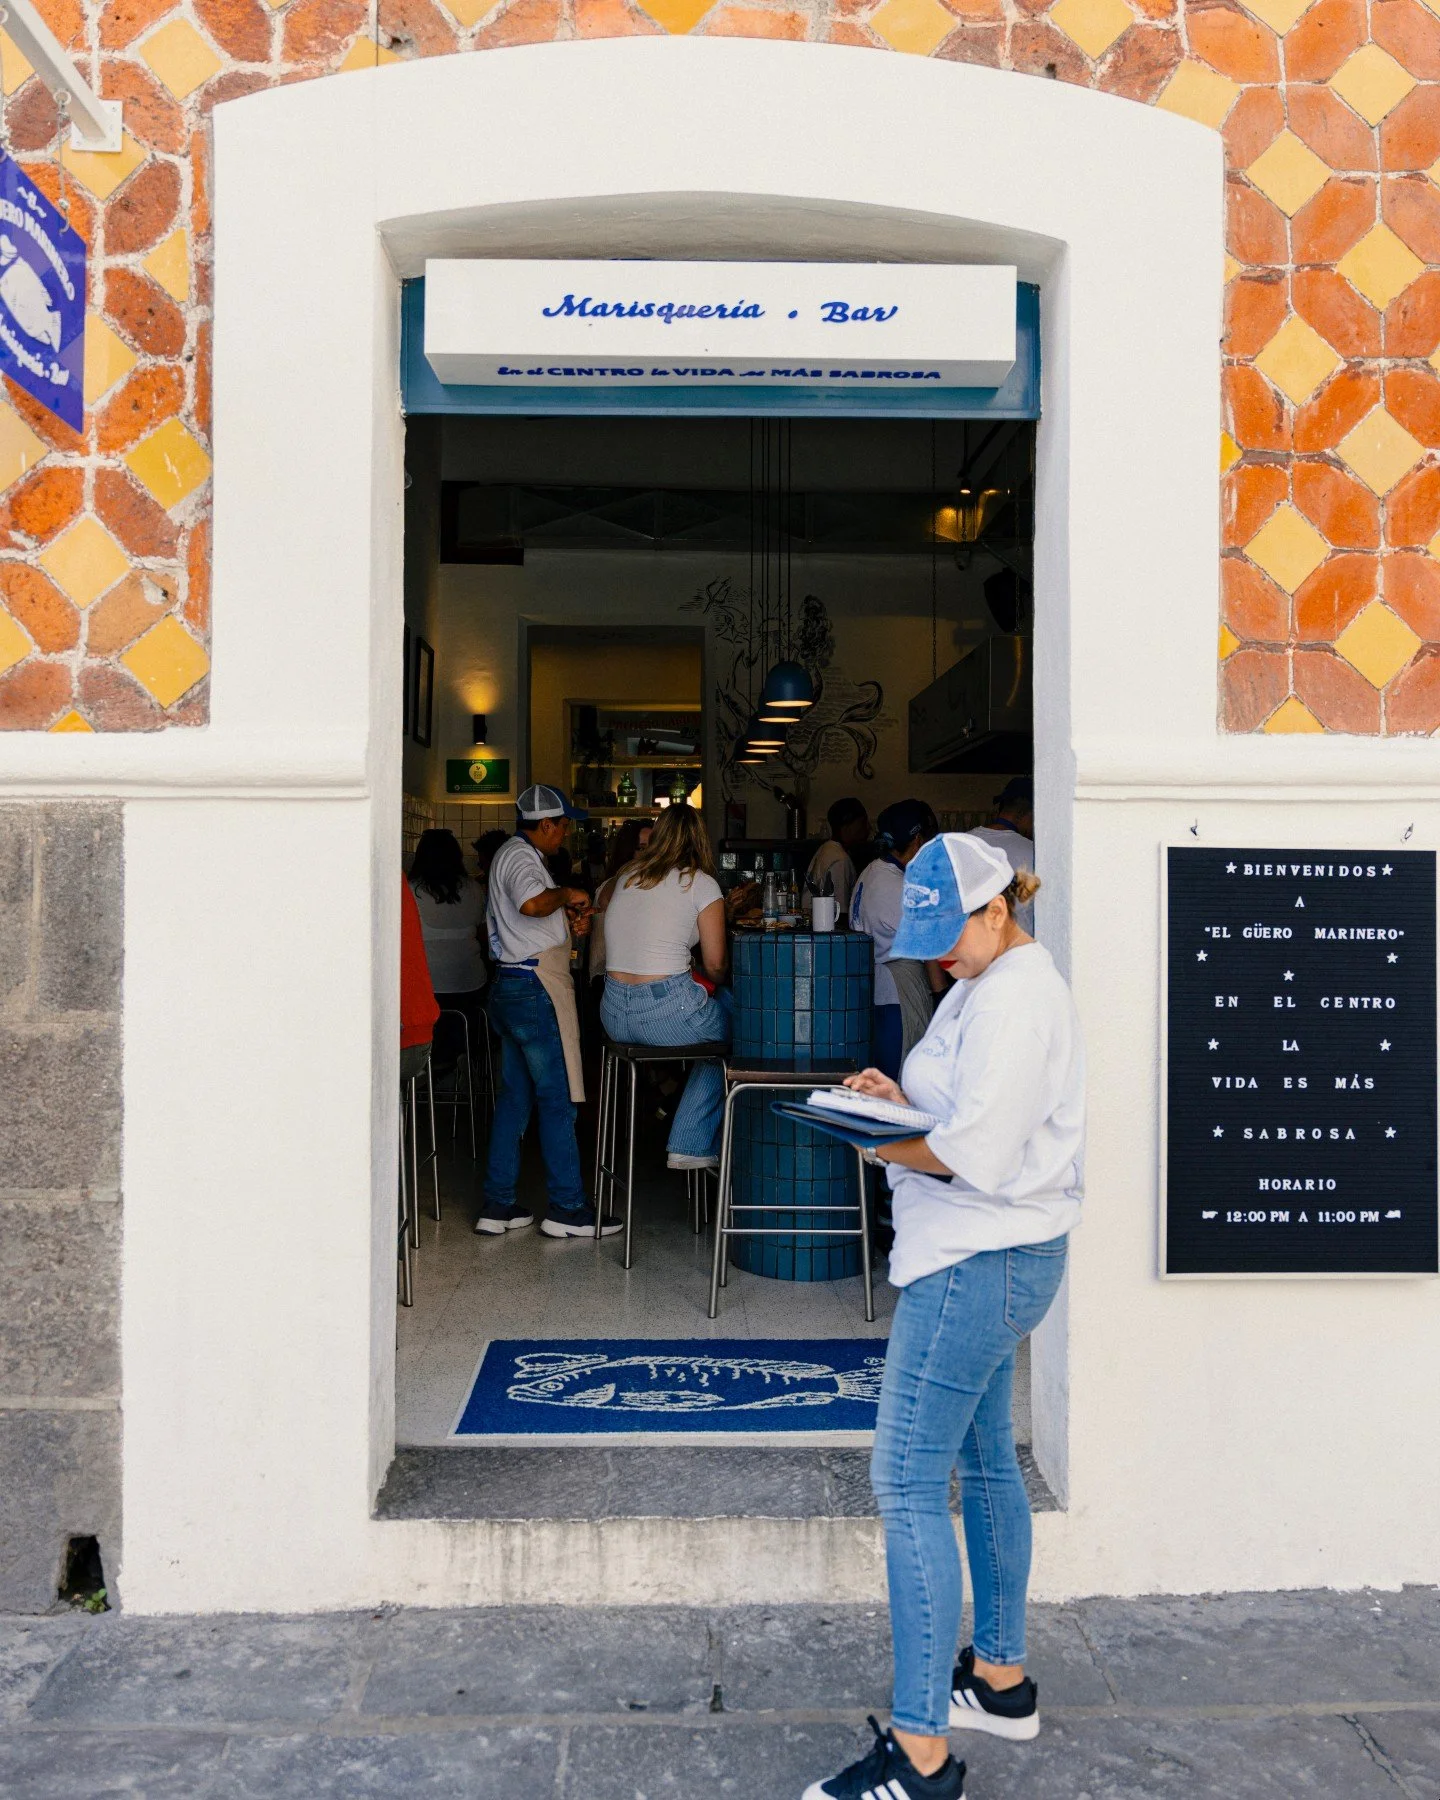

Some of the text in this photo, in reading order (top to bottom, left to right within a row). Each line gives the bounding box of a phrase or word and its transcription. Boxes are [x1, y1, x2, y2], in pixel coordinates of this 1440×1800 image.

[542, 293, 898, 325] Marisquería Bar
[497, 366, 524, 376] En
[527, 367, 544, 376] el
[547, 367, 645, 377] CENTRO
[650, 367, 670, 377] la
[672, 368, 735, 377] VIDA
[829, 369, 941, 379] SABROSA
[1243, 863, 1377, 878] BIENVENIDOS
[1294, 895, 1305, 908] A
[1242, 923, 1293, 940] GÜERO
[1214, 996, 1396, 1009] EN EL CENTRO
[1282, 1039, 1300, 1052] LA
[1211, 1073, 1375, 1090] VIDA ES MÁS
[1243, 1126, 1356, 1141] SABROSA
[1258, 1178, 1337, 1191] HORARIO
[1226, 1210, 1380, 1223] 12:00 PM A 11:00 PM
